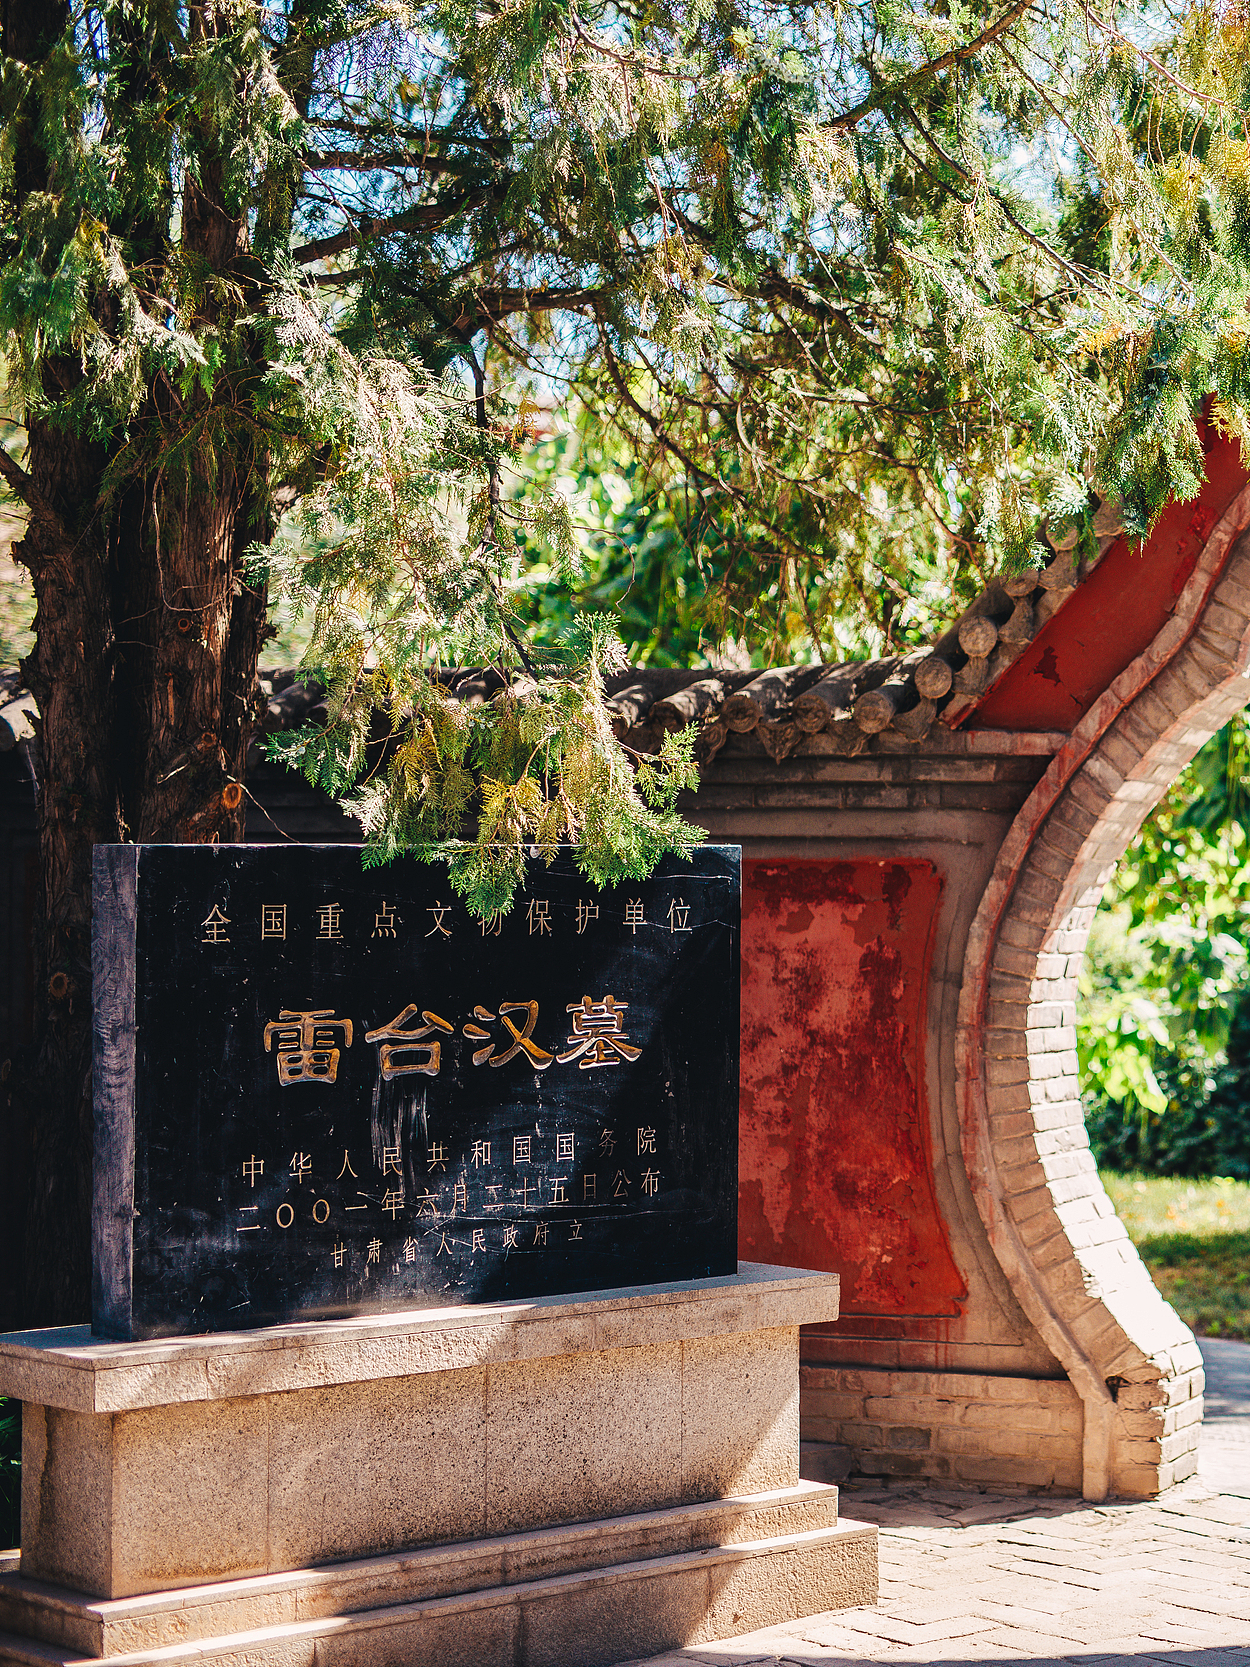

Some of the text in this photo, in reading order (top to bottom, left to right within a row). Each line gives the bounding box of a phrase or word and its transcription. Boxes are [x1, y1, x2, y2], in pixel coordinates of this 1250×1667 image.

[200, 897, 693, 944] 全国重点文物保护单位
[264, 995, 643, 1086] 雷台汉墓
[242, 1126, 657, 1187] 中华人民共和国国务院
[330, 1219, 583, 1268] 甘肃省人民政府立
